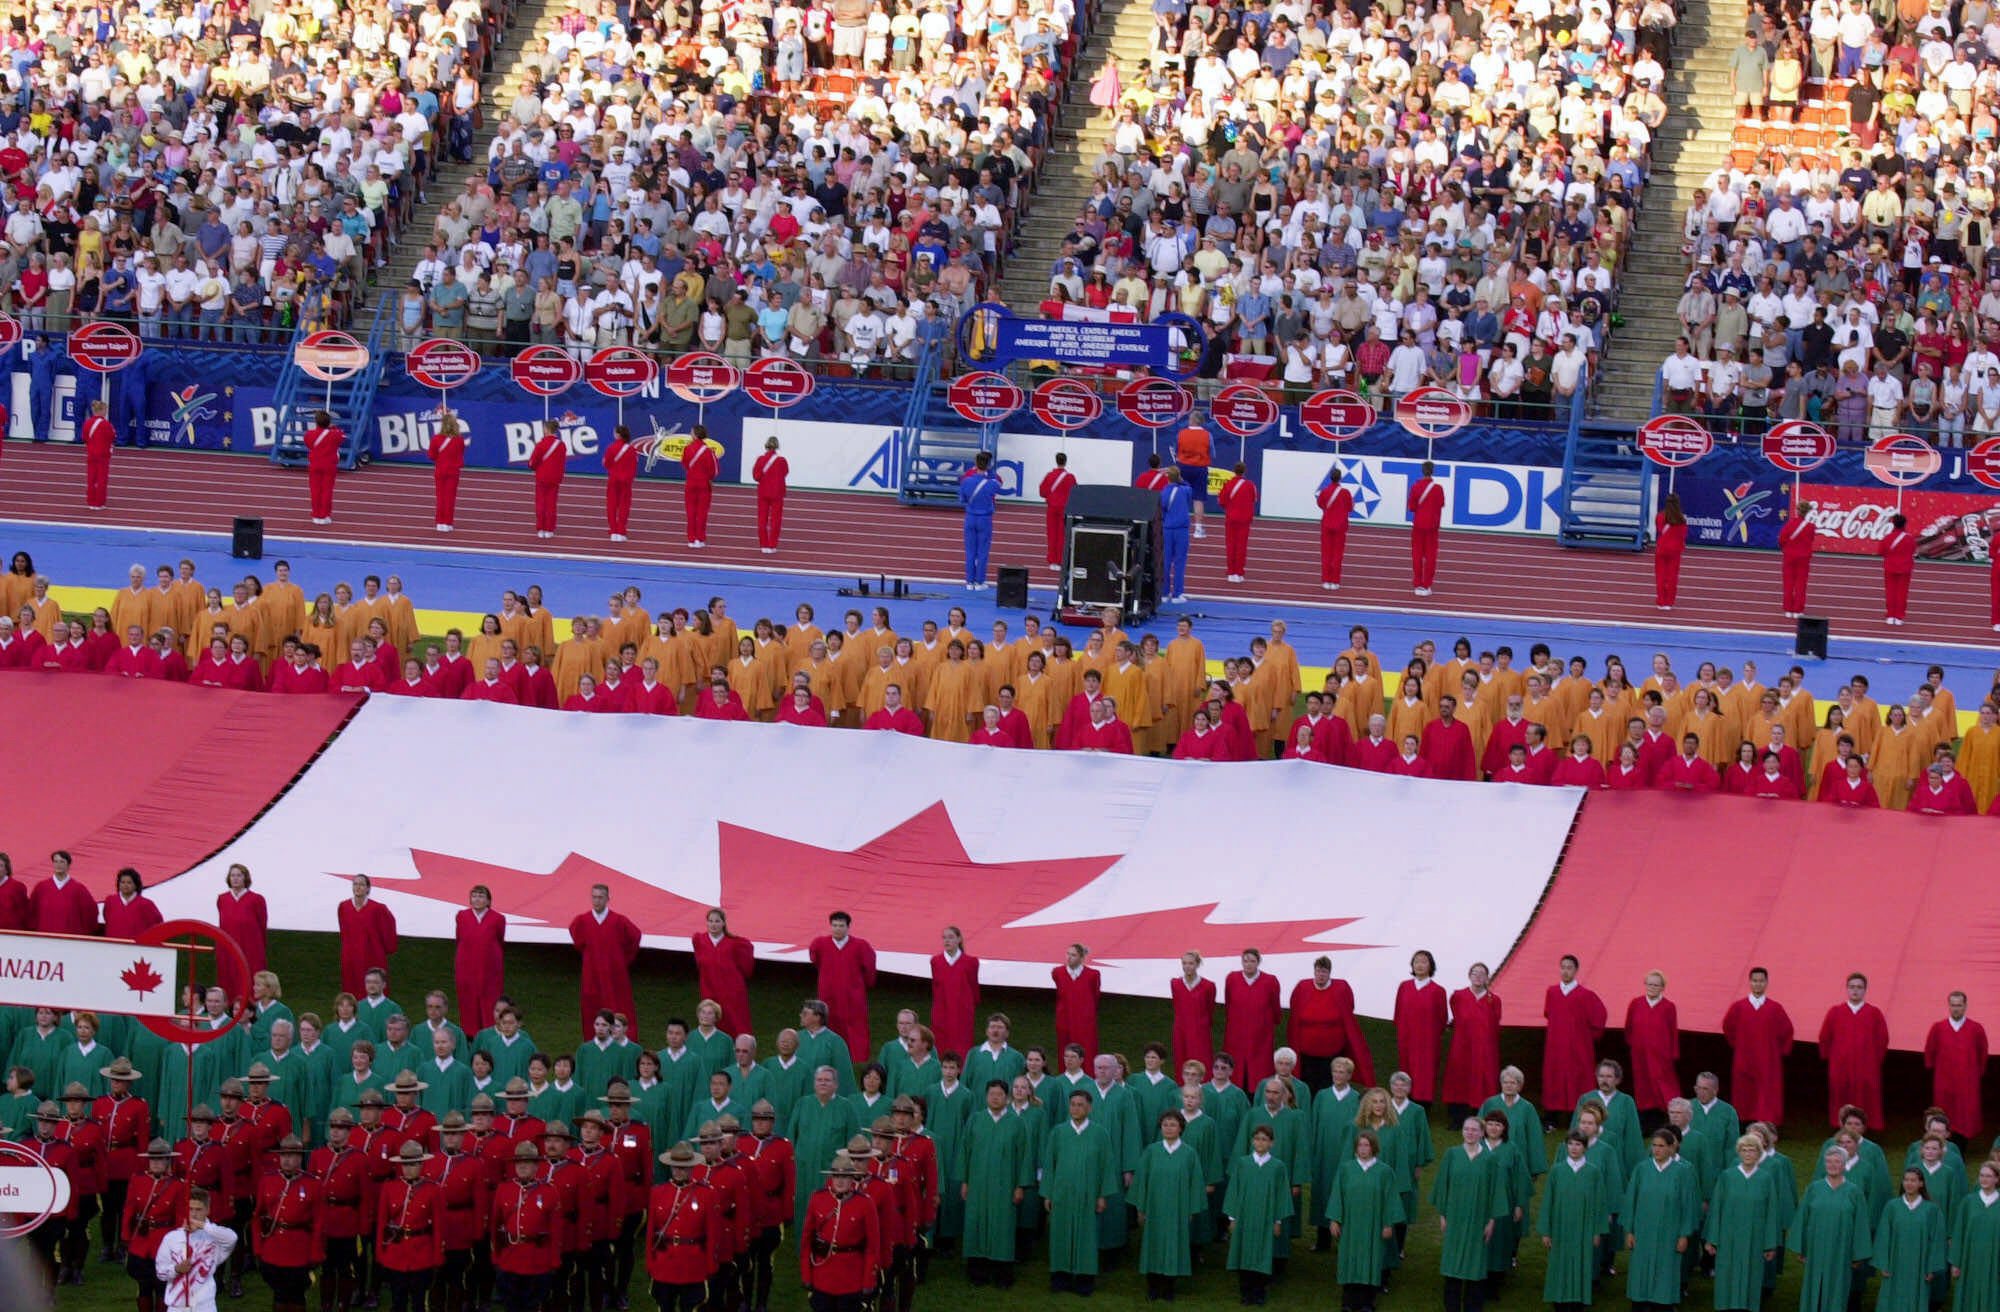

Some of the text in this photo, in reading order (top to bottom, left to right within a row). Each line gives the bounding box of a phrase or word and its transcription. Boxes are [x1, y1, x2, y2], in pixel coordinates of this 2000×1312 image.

[1280, 414, 1294, 438] L
[1382, 460, 1595, 531] TDK
[0, 956, 65, 982] NADA
